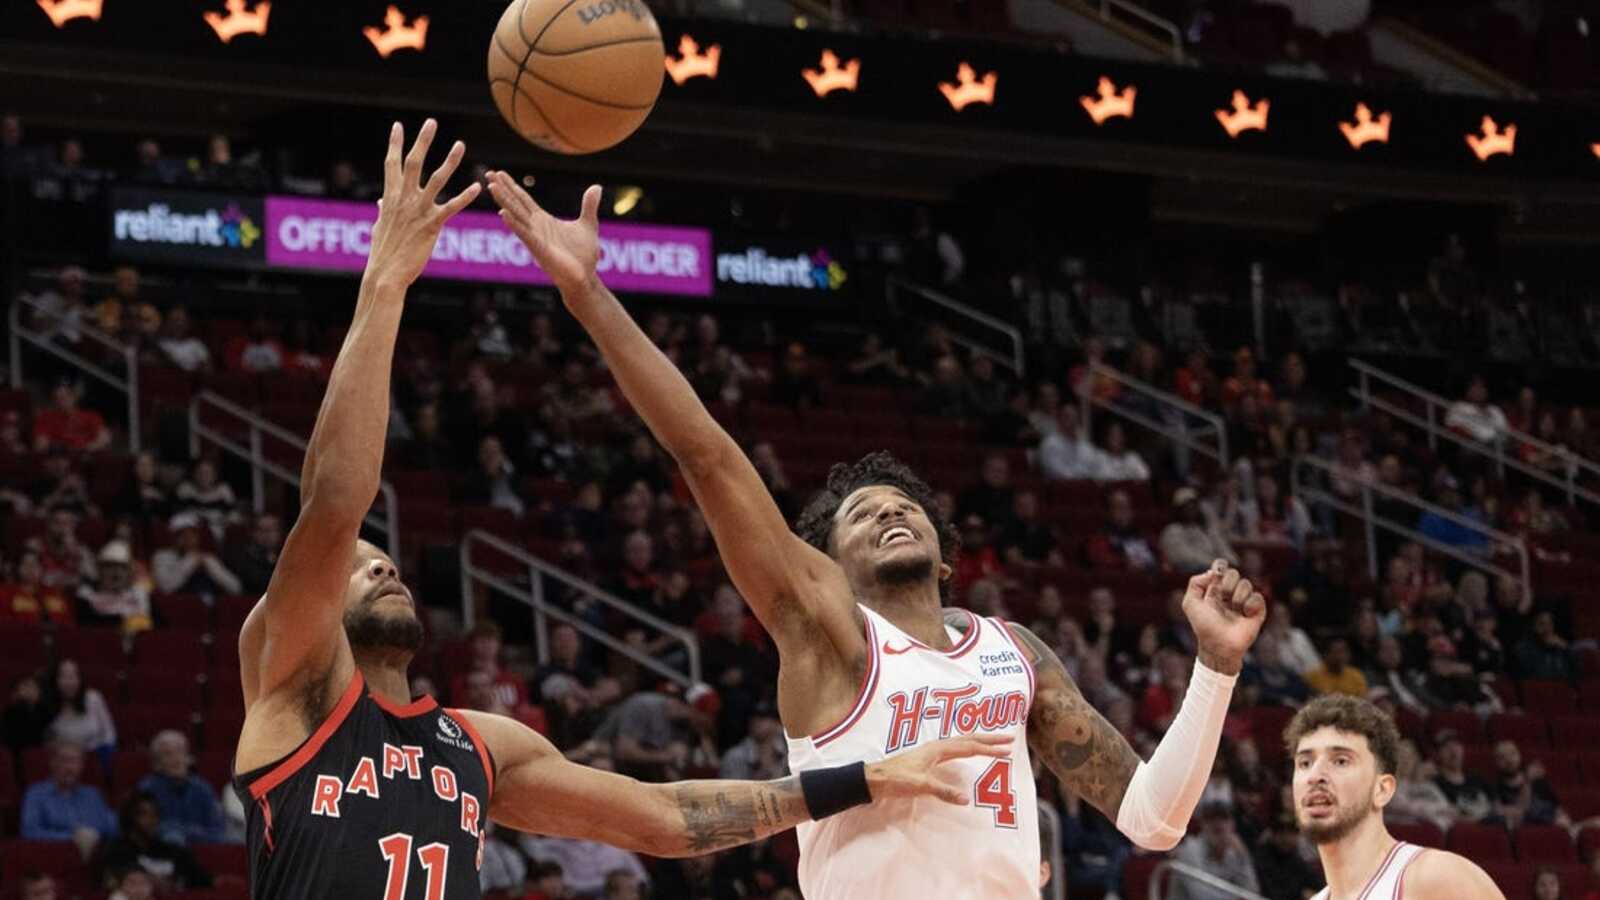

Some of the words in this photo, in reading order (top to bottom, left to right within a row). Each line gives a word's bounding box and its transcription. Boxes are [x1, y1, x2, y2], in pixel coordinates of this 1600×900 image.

[114, 204, 223, 246] reliant
[279, 217, 372, 254] OFFIC
[432, 227, 532, 267] ENERG
[596, 238, 697, 277] OVIDER
[717, 247, 813, 287] reliant
[980, 651, 1017, 664] credit
[981, 665, 1023, 676] karma
[886, 685, 1027, 754] H-Town
[975, 757, 1018, 828] 4
[378, 833, 449, 900] 11
